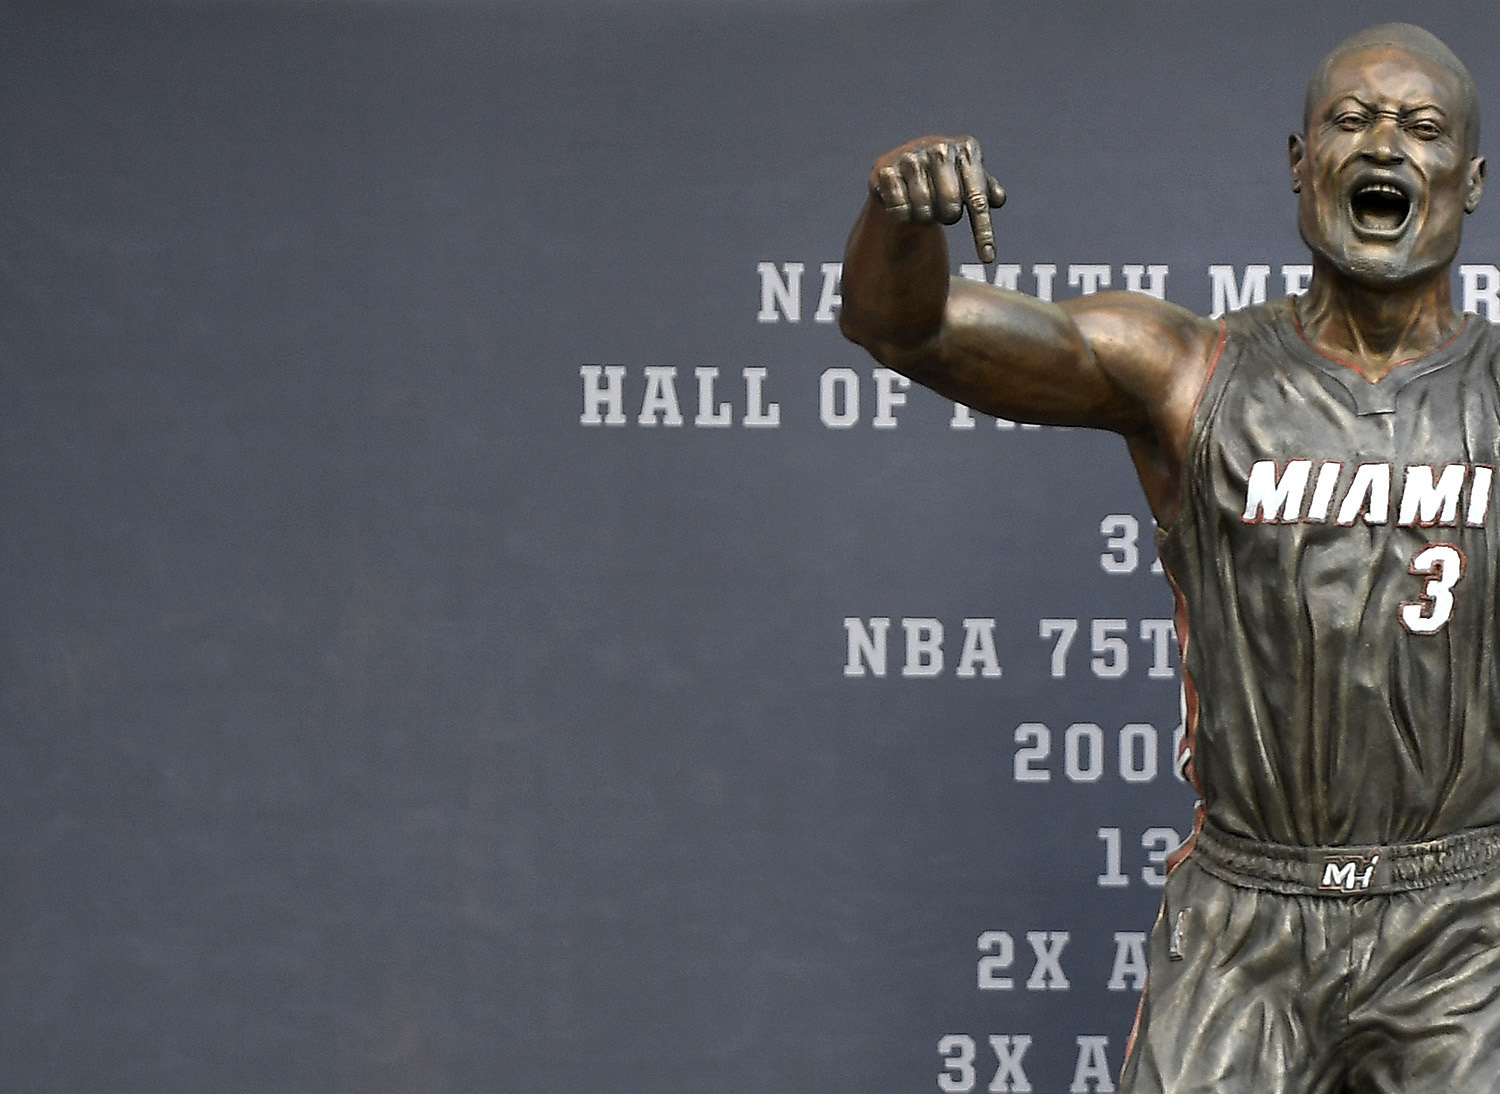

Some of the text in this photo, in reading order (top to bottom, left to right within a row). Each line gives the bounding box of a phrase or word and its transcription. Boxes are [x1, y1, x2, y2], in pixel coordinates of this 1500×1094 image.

[579, 365, 783, 428] HALL
[819, 367, 913, 429] OF
[1241, 457, 1495, 528] MIAMI
[1399, 542, 1468, 636] 3
[843, 616, 1002, 678] NBA
[1039, 618, 1180, 679] 75T
[1097, 827, 1181, 887] 13
[977, 931, 1071, 990] 2X
[937, 1034, 1033, 1094] 3X
